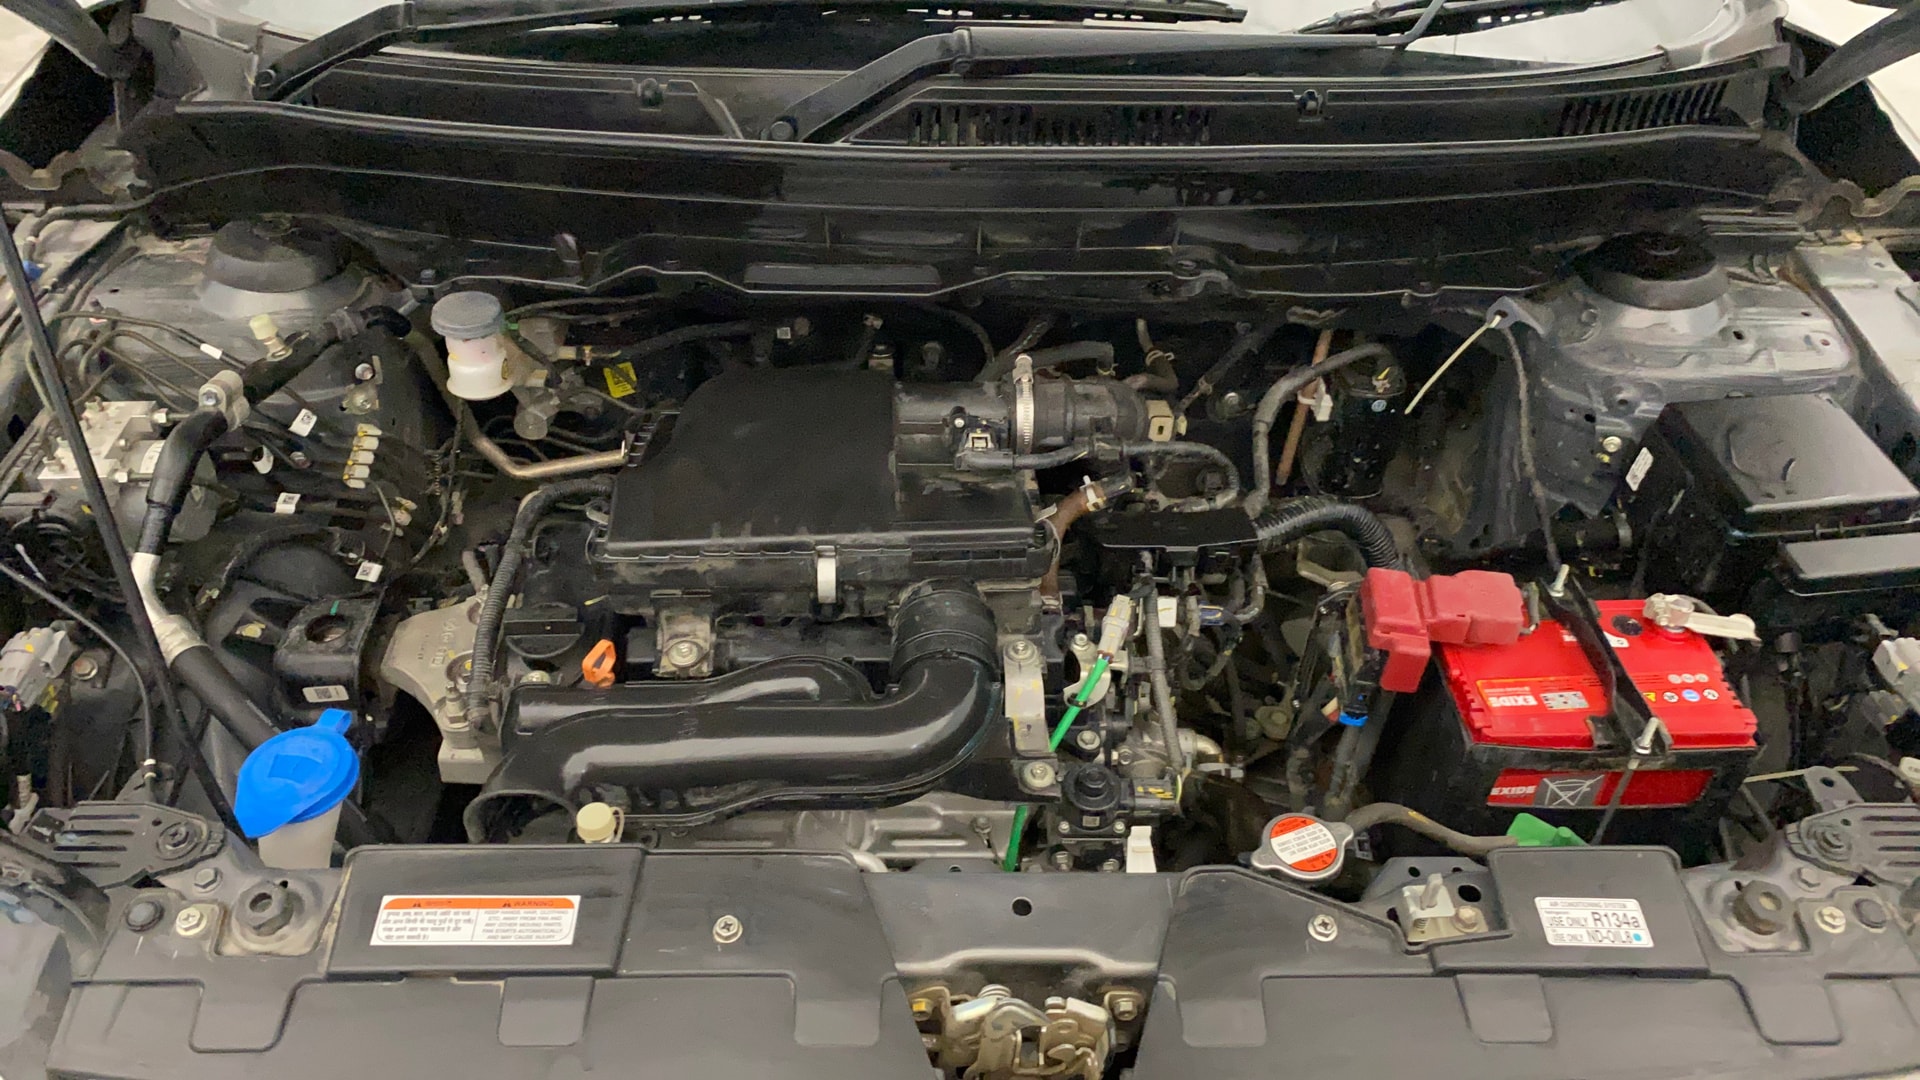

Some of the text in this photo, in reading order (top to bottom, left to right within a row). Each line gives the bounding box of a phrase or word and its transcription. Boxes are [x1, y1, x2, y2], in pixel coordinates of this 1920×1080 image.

[1488, 695, 1538, 707] EXIDE
[1490, 786, 1538, 795] EXIDE
[1547, 912, 1640, 928] USE ONLY R134a
